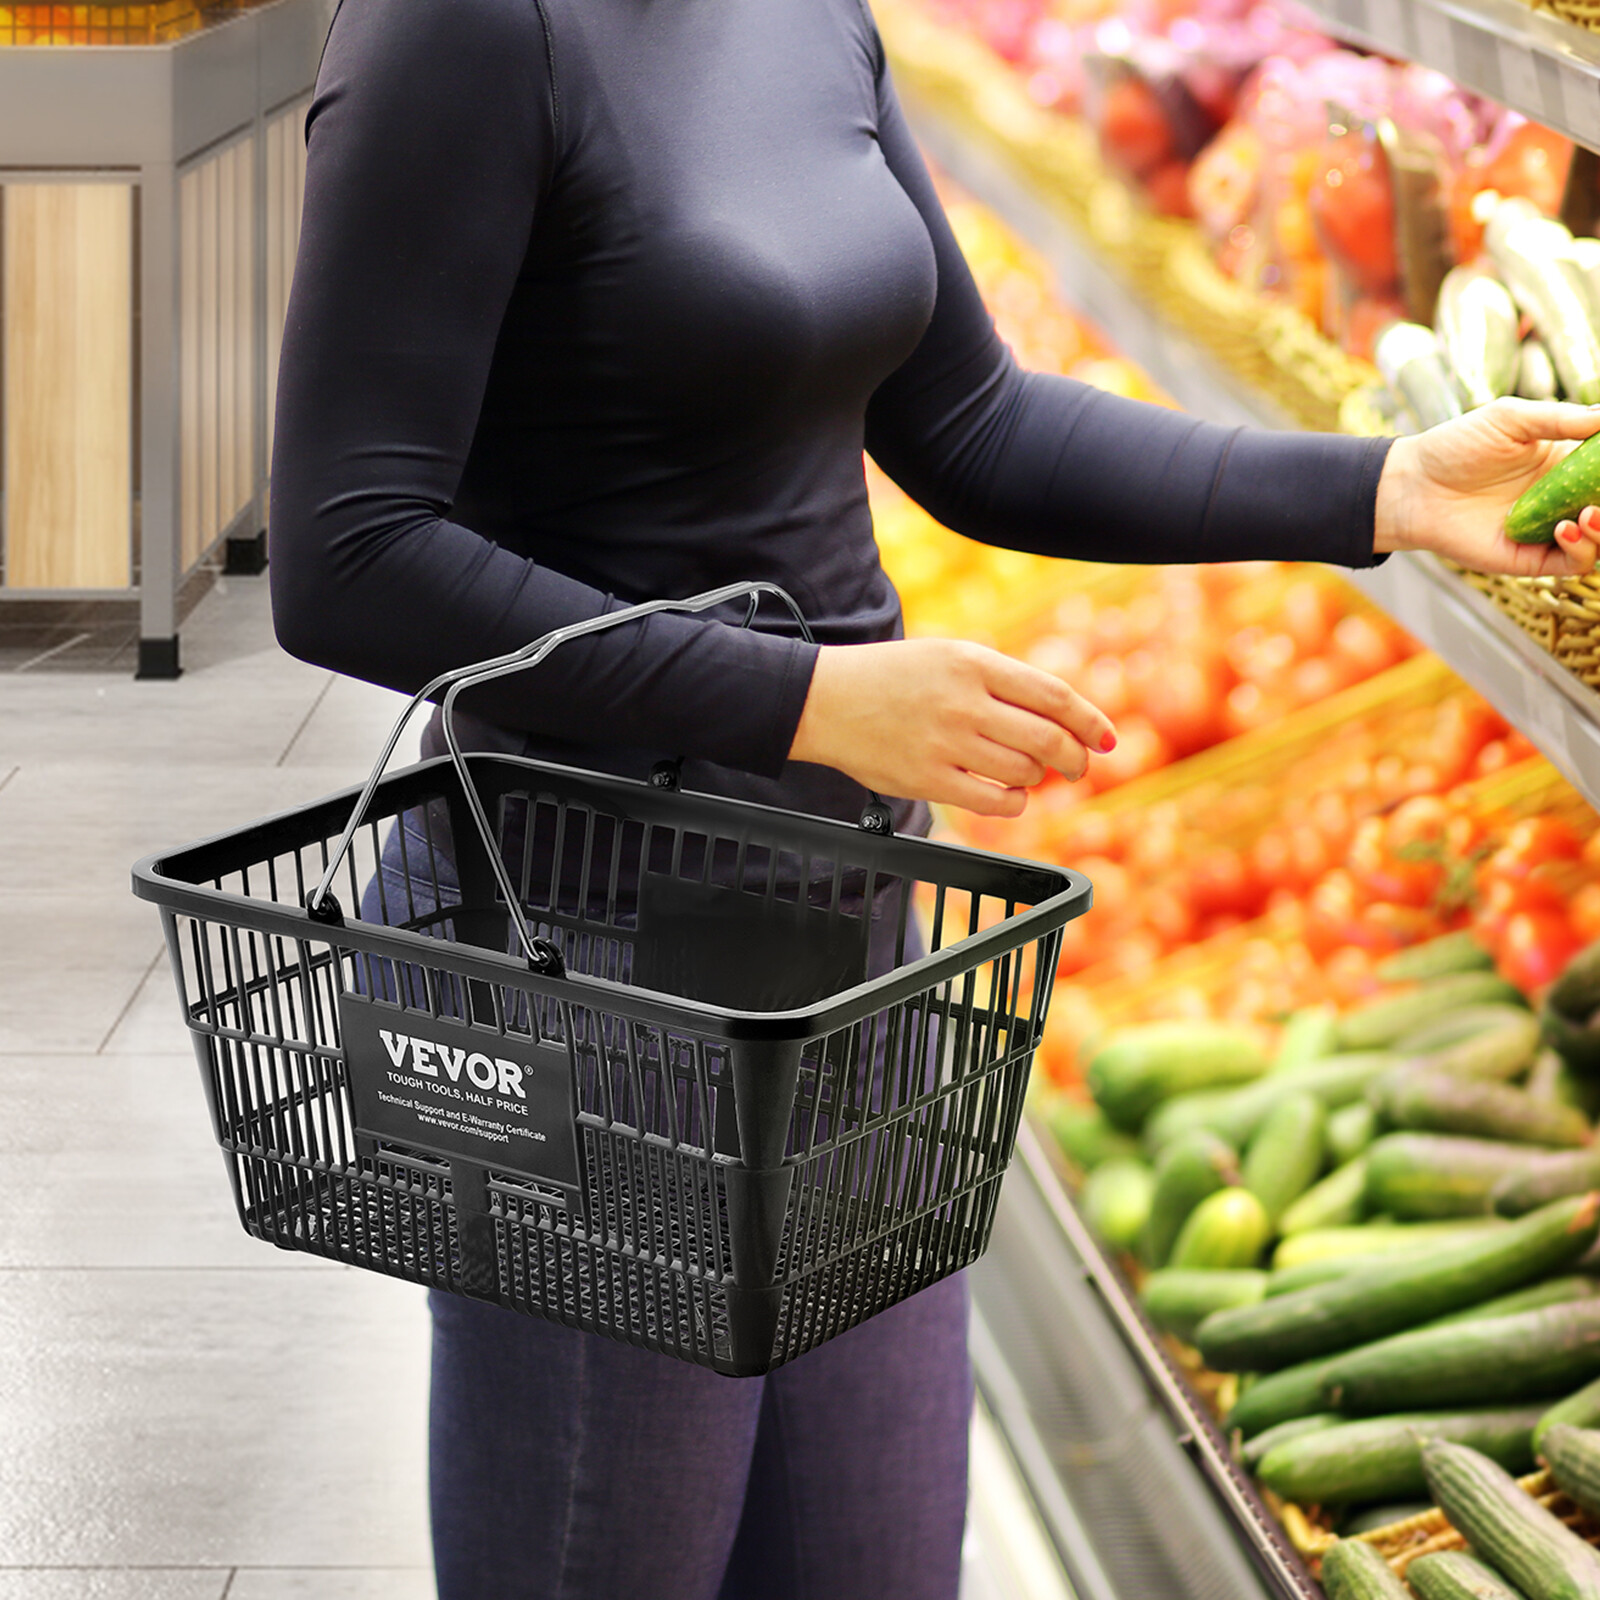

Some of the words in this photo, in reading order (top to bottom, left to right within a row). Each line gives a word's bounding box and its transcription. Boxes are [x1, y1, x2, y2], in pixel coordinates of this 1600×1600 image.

[377, 1090, 413, 1109] Technical
[414, 1100, 445, 1118] Support
[446, 1109, 460, 1121] and
[462, 1112, 505, 1134] E-Warranty
[506, 1124, 546, 1142] Certificate
[386, 1071, 423, 1090] TOUGH
[425, 1082, 464, 1101] TOOLS,
[466, 1091, 493, 1107] HALF
[496, 1100, 529, 1116] PRICE
[417, 1113, 510, 1144] www.vevor.com/support
